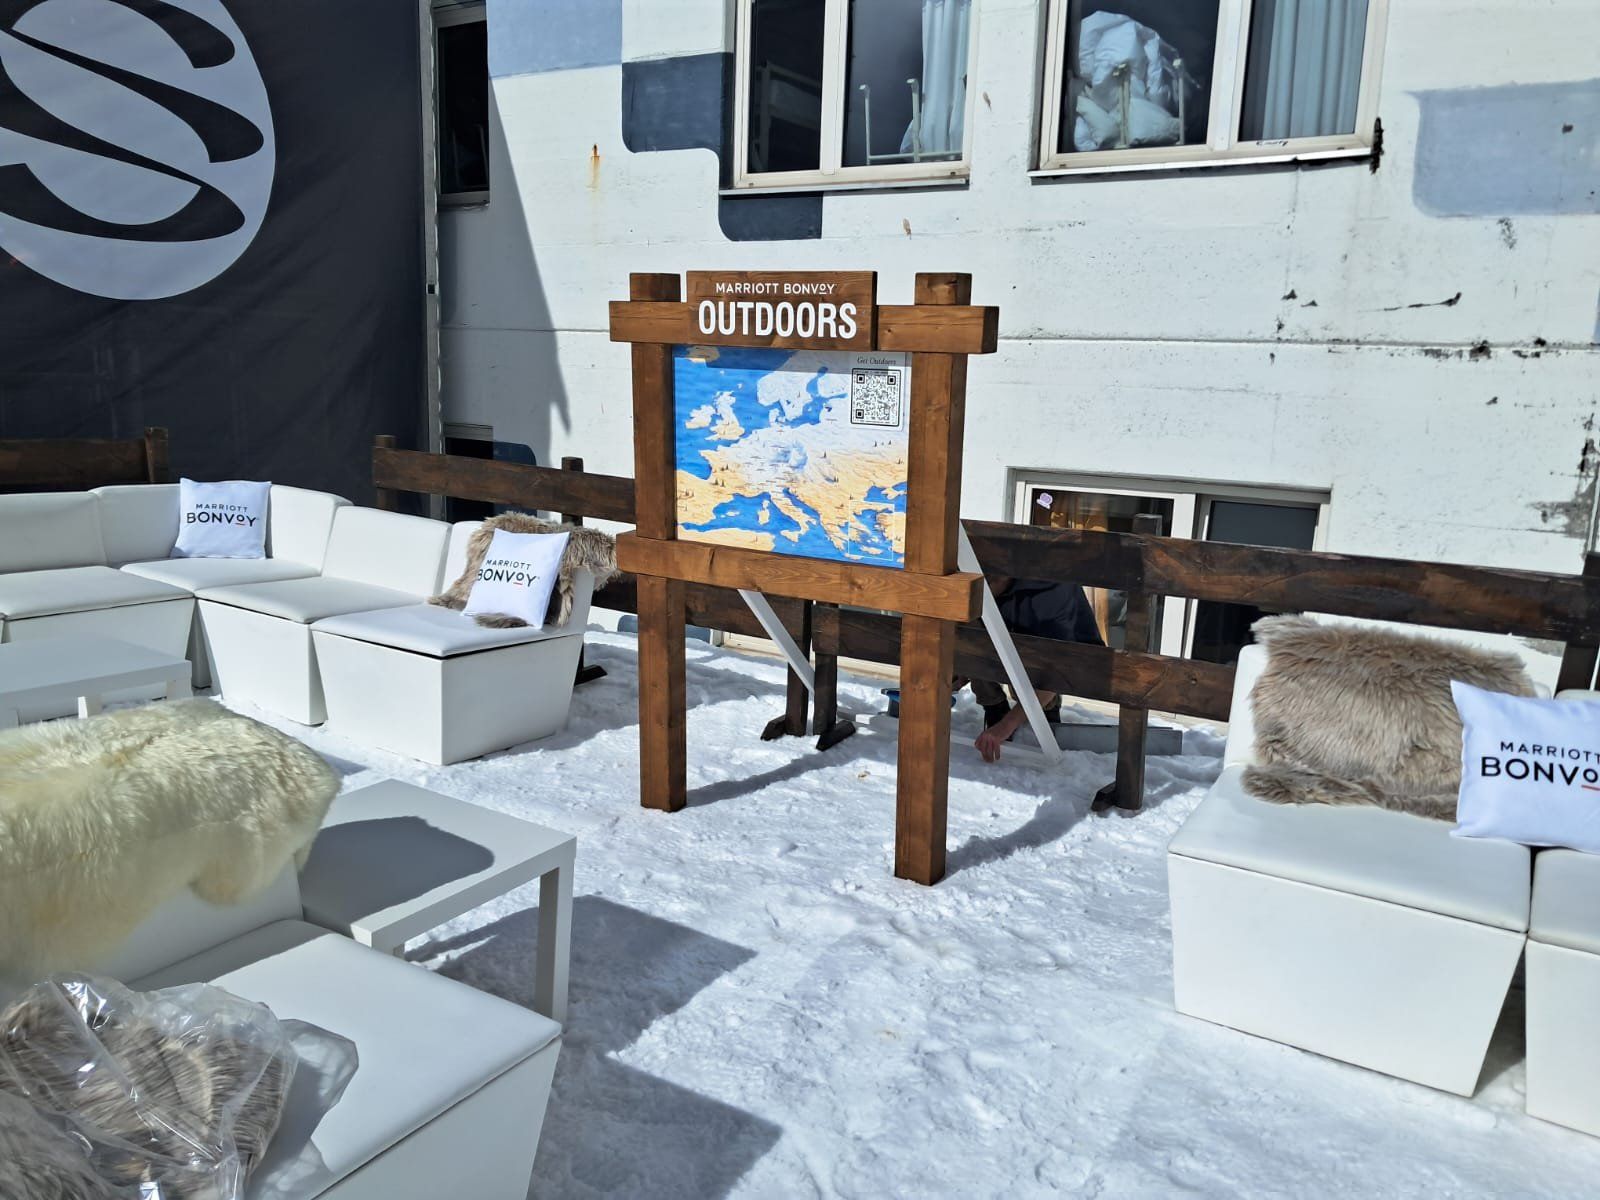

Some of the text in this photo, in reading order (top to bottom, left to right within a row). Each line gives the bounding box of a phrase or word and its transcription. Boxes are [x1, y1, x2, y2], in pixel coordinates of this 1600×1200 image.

[715, 282, 835, 295] MARRIOTT BONVOY
[698, 300, 857, 339] OUTDOORS
[196, 504, 248, 512] MARRIOTT
[186, 512, 256, 527] BONVOY
[486, 560, 531, 570] MARRIOTT
[1500, 741, 1600, 765] MARRIOTT
[1481, 756, 1600, 791] BONVO
